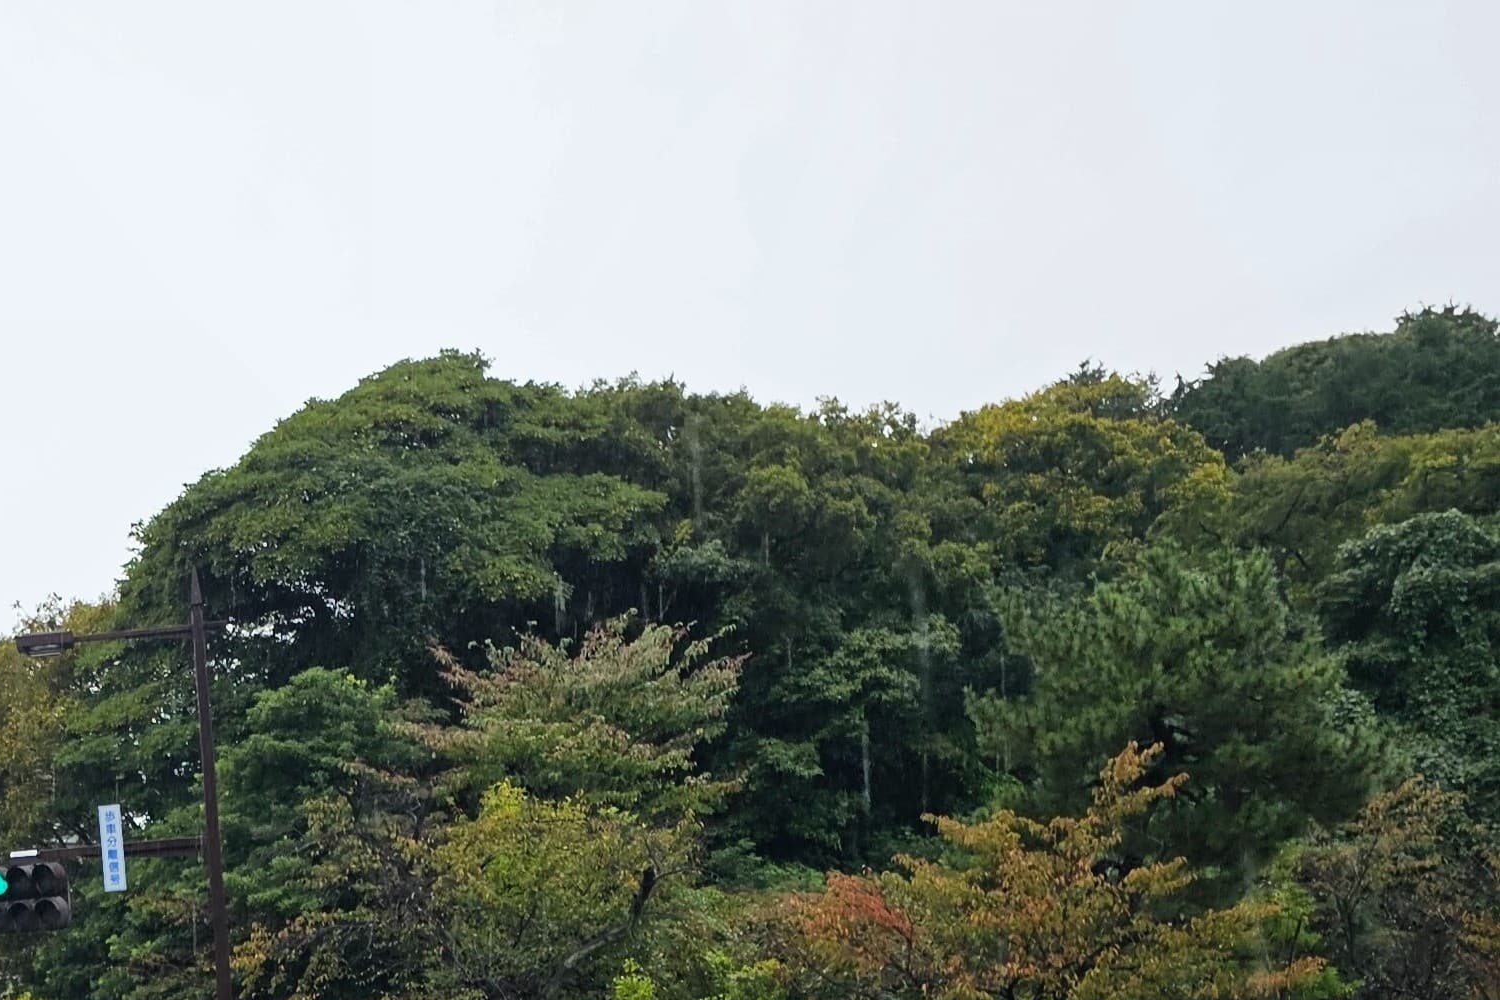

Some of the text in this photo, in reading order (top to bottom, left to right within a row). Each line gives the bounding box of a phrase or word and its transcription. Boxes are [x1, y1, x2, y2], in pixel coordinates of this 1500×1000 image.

[105, 811, 120, 885] 歩車分離信号
